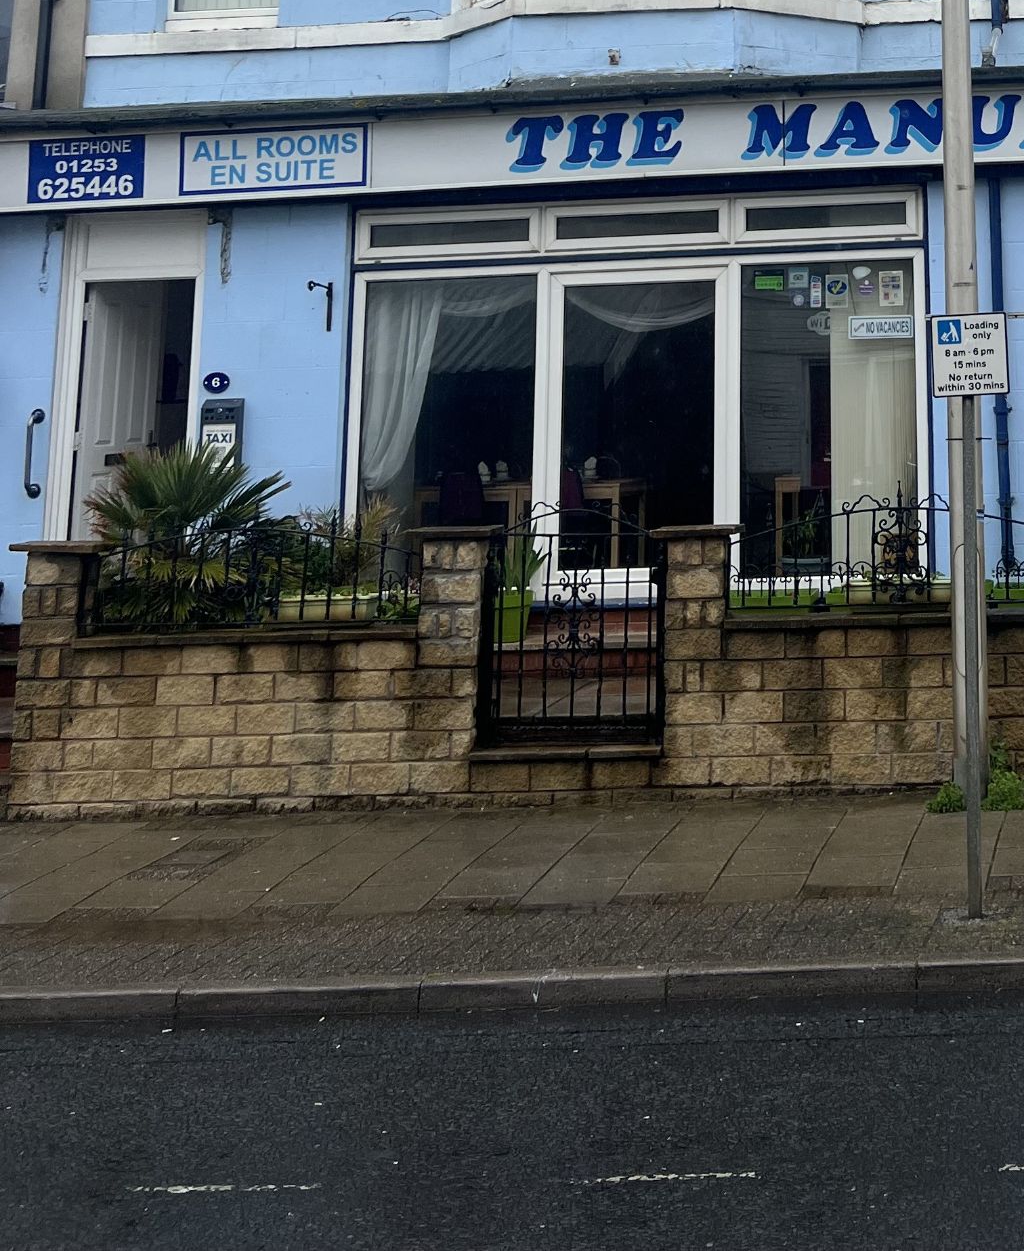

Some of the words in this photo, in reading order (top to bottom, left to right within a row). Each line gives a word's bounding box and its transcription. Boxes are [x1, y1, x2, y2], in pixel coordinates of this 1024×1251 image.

[505, 108, 684, 173] THE
[43, 139, 132, 158] TELEPHONE
[193, 139, 248, 163] ALL
[256, 132, 358, 159] ROOMS
[55, 158, 118, 174] 01253
[210, 164, 246, 186] EN
[256, 158, 336, 183] SUITE
[37, 174, 134, 201] 625446
[865, 321, 875, 334] NO
[876, 320, 910, 334] VACANCIES
[964, 322, 999, 330] Loading
[972, 331, 991, 340] only
[945, 349, 951, 357] 8
[972, 348, 979, 356] 6
[953, 361, 963, 369] 15
[965, 360, 986, 368] mins
[212, 377, 220, 387] 6
[949, 373, 961, 381] No
[964, 372, 993, 380] return
[937, 383, 965, 392] within
[968, 382, 981, 391] 30
[983, 381, 1005, 389] mins
[206, 433, 232, 443] TAXI
